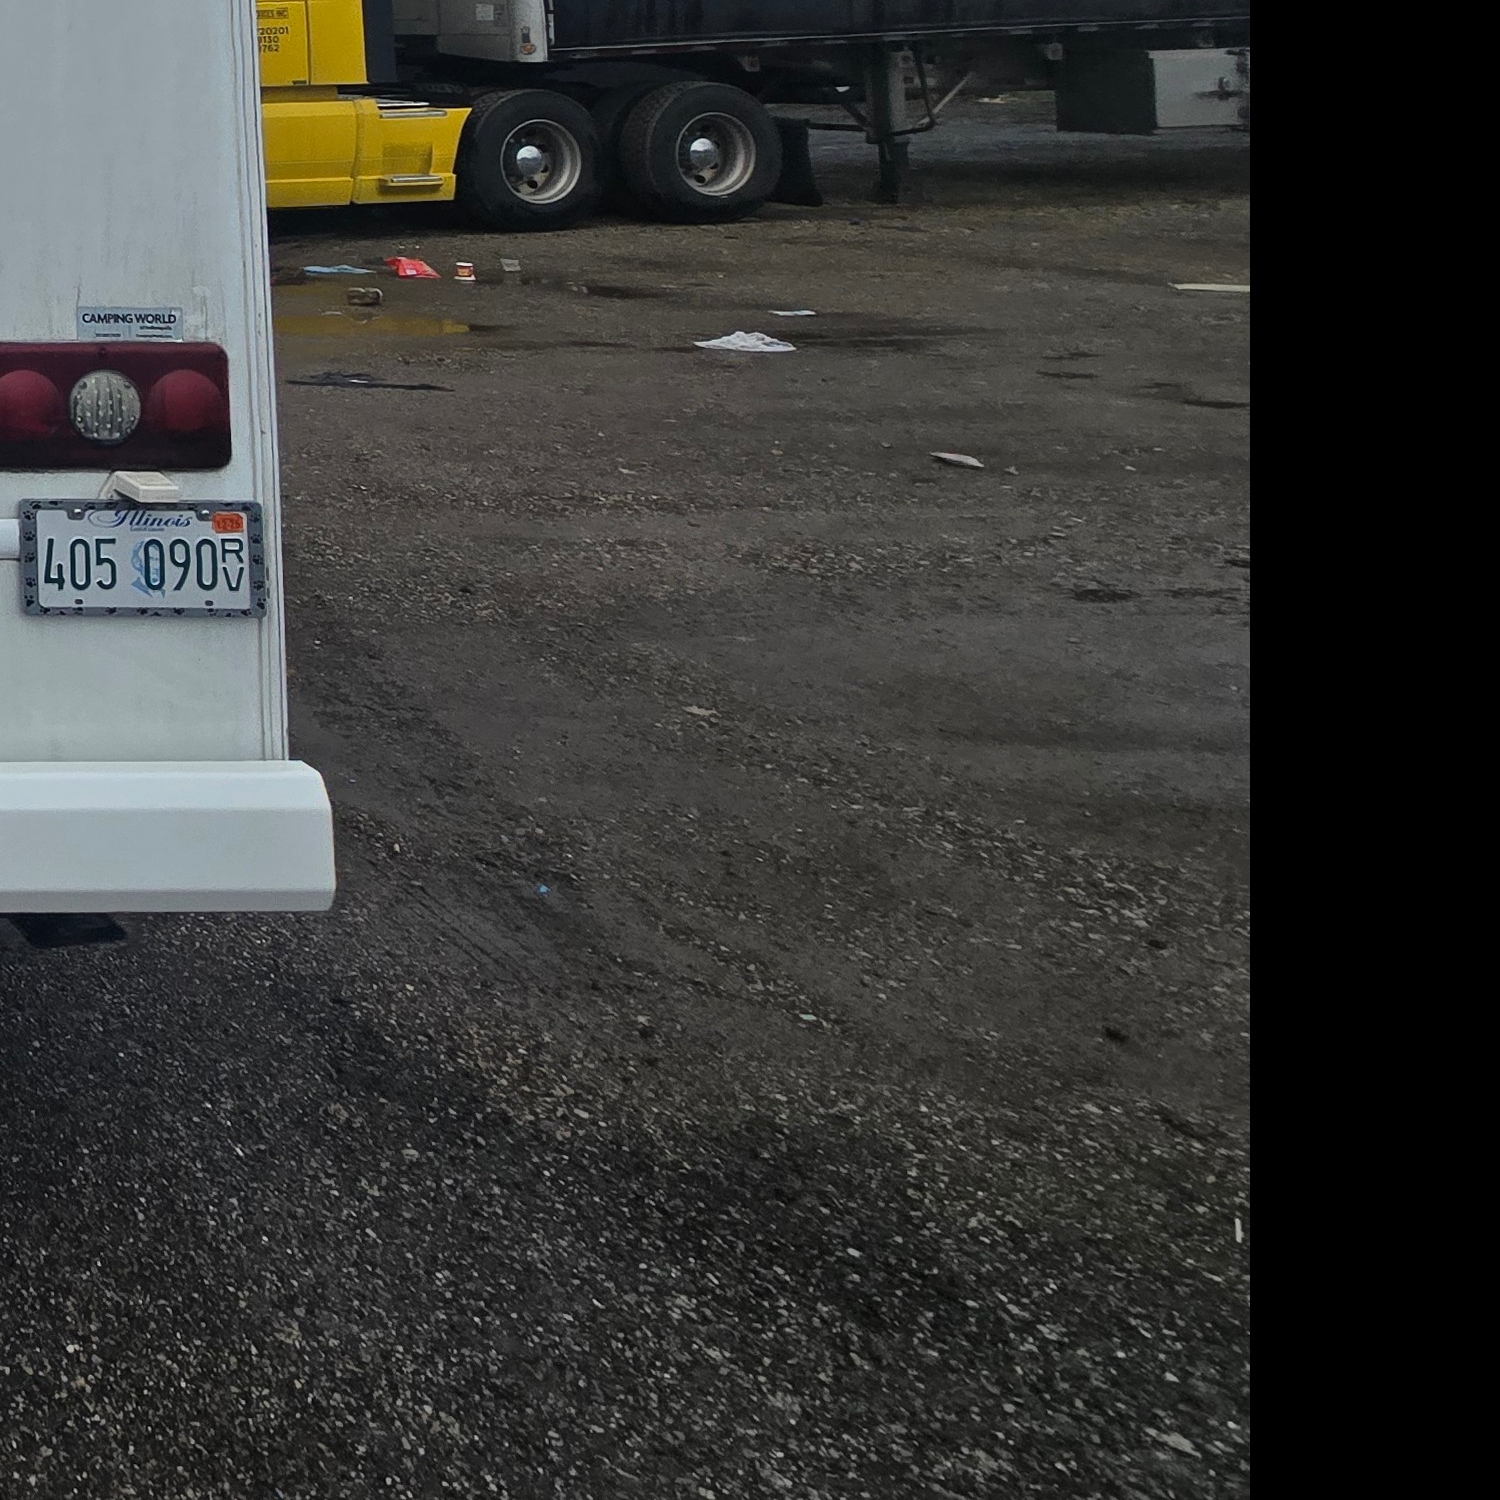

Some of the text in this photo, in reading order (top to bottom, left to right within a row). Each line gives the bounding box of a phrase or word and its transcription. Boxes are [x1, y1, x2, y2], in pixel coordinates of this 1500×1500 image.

[82, 313, 177, 324] CAMPING WORLD
[88, 510, 193, 528] Illinois
[44, 537, 117, 591] 405
[143, 537, 219, 591] 090
